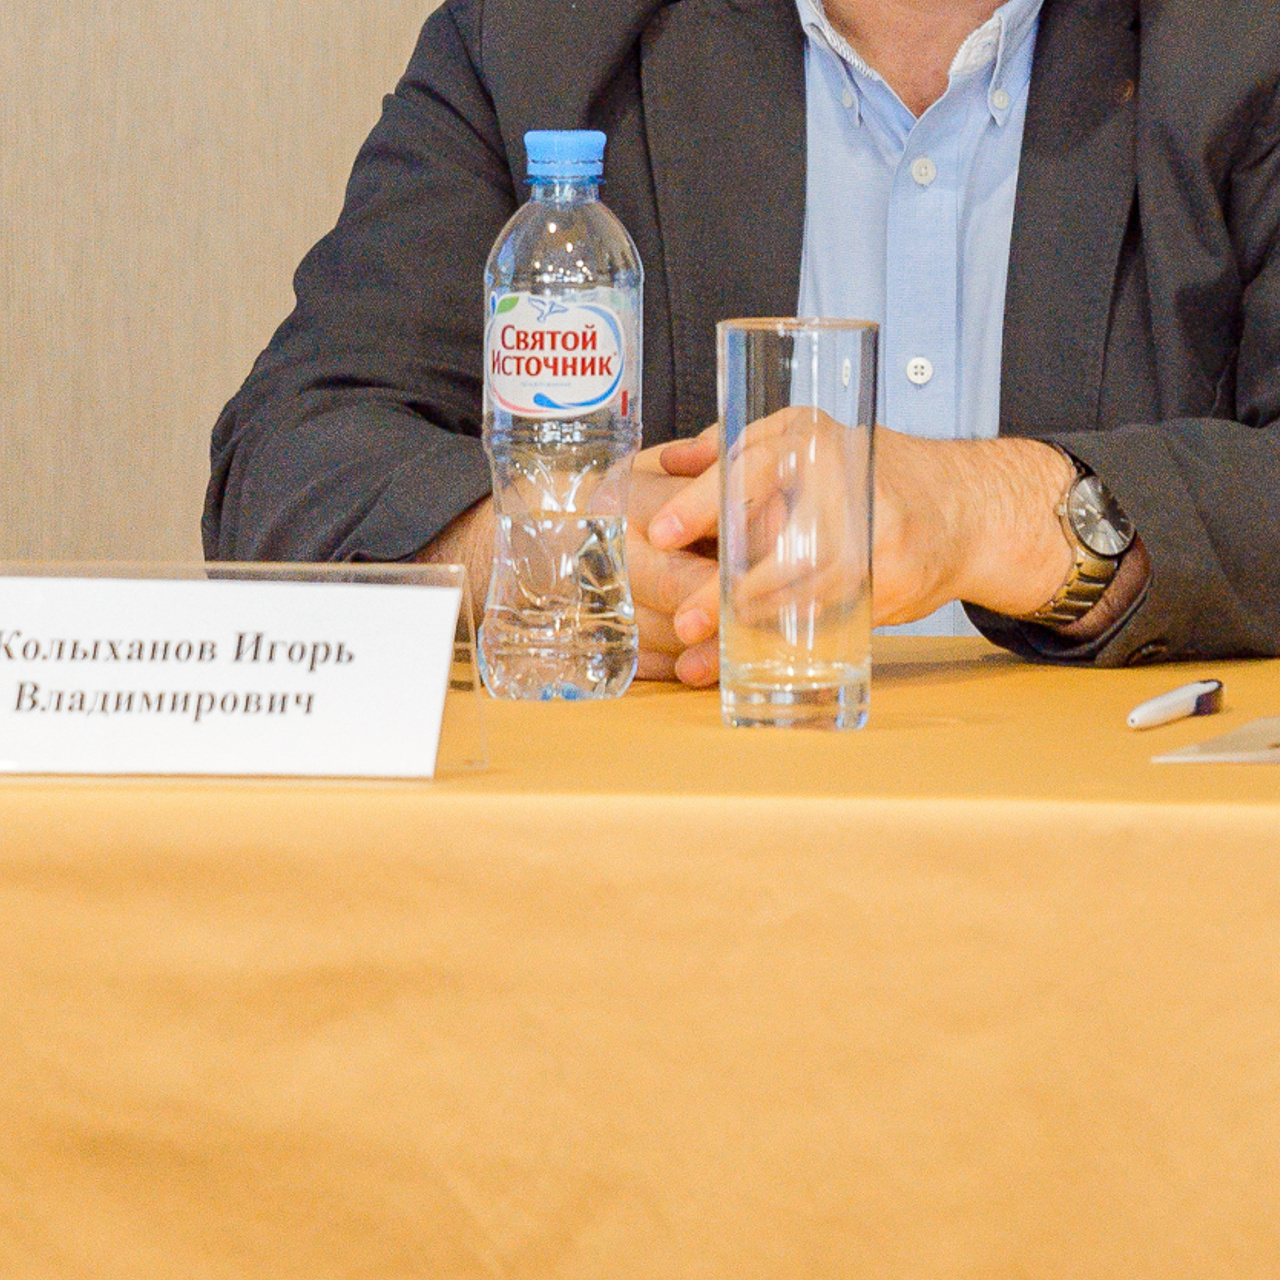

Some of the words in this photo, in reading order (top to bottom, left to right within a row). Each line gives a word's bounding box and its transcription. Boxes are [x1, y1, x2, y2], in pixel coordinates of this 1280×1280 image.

[500, 324, 598, 351] Святой
[490, 349, 613, 377] Источник
[233, 631, 356, 672] Игорь
[14, 681, 315, 722] Владимирович
